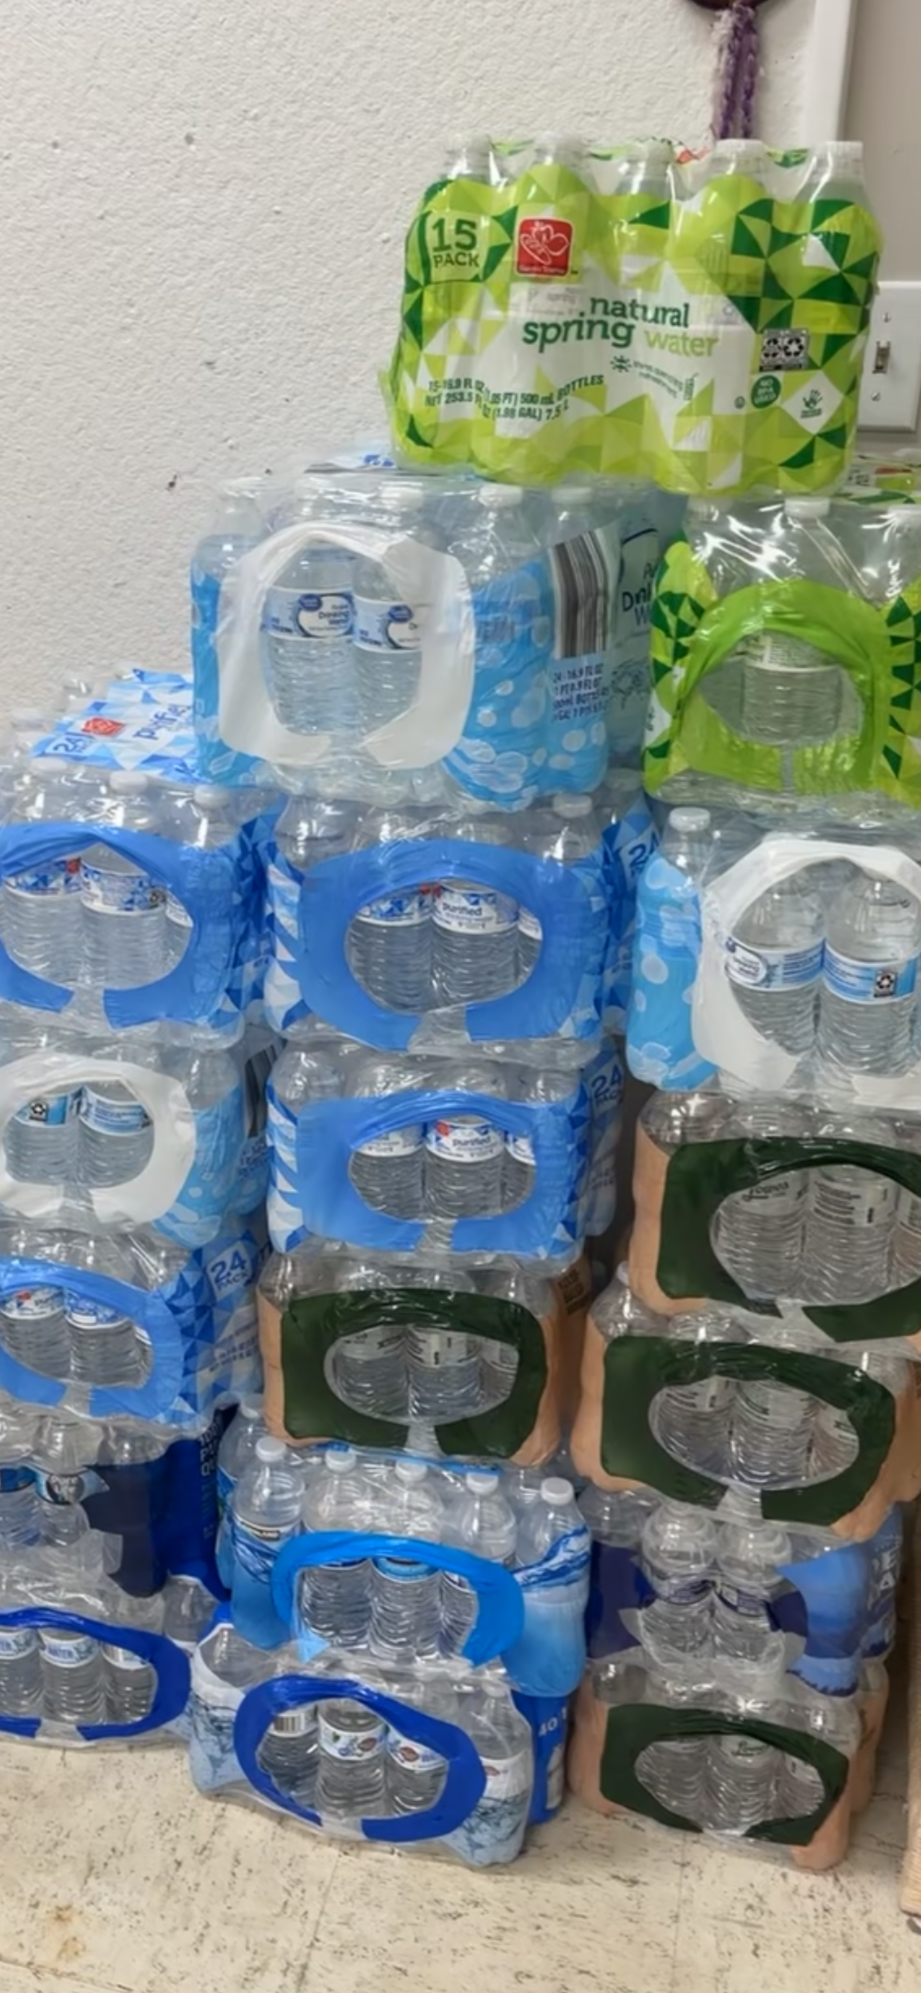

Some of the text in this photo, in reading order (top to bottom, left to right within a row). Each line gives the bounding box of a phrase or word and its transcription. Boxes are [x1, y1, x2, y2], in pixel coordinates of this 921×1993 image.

[432, 217, 477, 251] 15
[432, 251, 480, 269] PACK
[590, 297, 690, 328] natural
[522, 311, 720, 357] spring water
[520, 392, 539, 405] 500
[557, 374, 605, 402] BOTTLES
[444, 390, 474, 405] 253.5
[518, 407, 543, 422] GAL)
[545, 404, 562, 420] 7.5
[592, 1063, 623, 1099] 24
[210, 1250, 247, 1285] 24
[216, 1271, 250, 1292] PACK
[538, 1716, 558, 1737] 40
